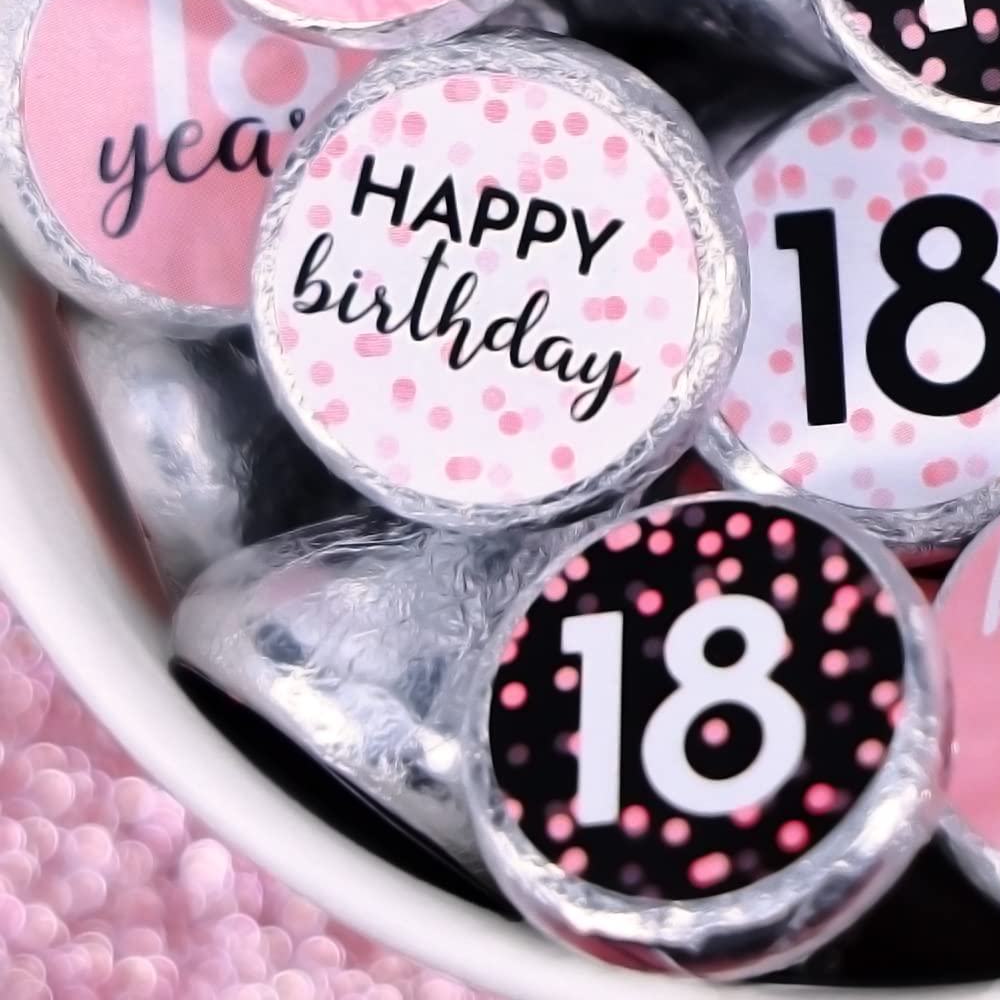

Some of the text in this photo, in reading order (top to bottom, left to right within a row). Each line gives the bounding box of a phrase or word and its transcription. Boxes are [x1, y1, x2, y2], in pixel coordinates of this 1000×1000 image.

[98, 107, 306, 239] yea
[351, 154, 625, 277] HAPPY
[293, 232, 640, 422] birthday
[561, 593, 807, 827] 18
